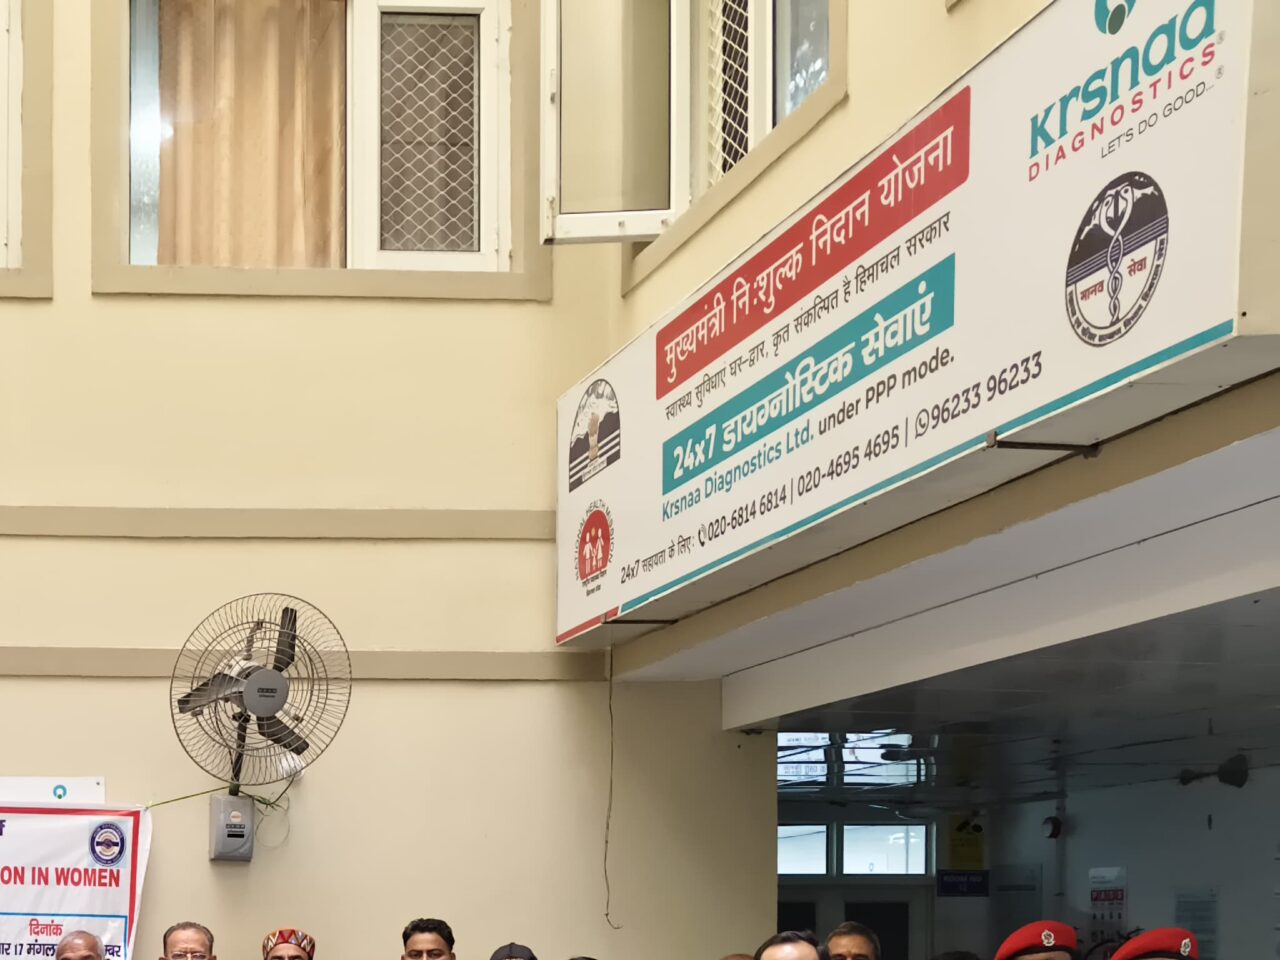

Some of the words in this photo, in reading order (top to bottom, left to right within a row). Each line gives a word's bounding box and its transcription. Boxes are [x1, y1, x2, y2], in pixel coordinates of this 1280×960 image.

[1028, 43, 1215, 182] DIAGNOSTICS
[1101, 128, 1134, 158] LET'S
[1138, 112, 1158, 135] DO
[664, 291, 726, 383] मुख्यमंत्री
[809, 190, 871, 266] निदान
[877, 125, 954, 208] योजना
[665, 391, 692, 421] स्वास्थ्य
[772, 323, 791, 358] कृत
[793, 290, 839, 335] संकल्पित
[843, 275, 852, 304] है
[854, 245, 900, 295] हिमाचल
[905, 210, 951, 257] सरकार
[1080, 280, 1105, 301] मानव
[1127, 256, 1147, 277] सेवा
[662, 487, 701, 522] Krsnaa
[704, 440, 782, 499] Diagnostics
[786, 418, 814, 455] Ltd.
[818, 398, 861, 436] under
[865, 374, 896, 410] PPP
[902, 347, 955, 390] mode.
[672, 424, 717, 481] 24x7
[721, 342, 856, 454] डायग्नोस्टिक
[861, 281, 935, 367] सेवाएं
[620, 559, 640, 584] 24x7
[642, 550, 666, 574] सहायता
[668, 540, 675, 559] के
[707, 503, 756, 542] 020-6814
[759, 485, 787, 516] 6814
[797, 445, 860, 497] 020-4695
[864, 425, 899, 462] 4695
[931, 381, 981, 430] 96233
[987, 350, 1042, 402] 96233
[29, 918, 64, 937] दिनांक
[31, 866, 49, 887] IN
[55, 867, 121, 888] WOMEN
[14, 943, 24, 956] 17
